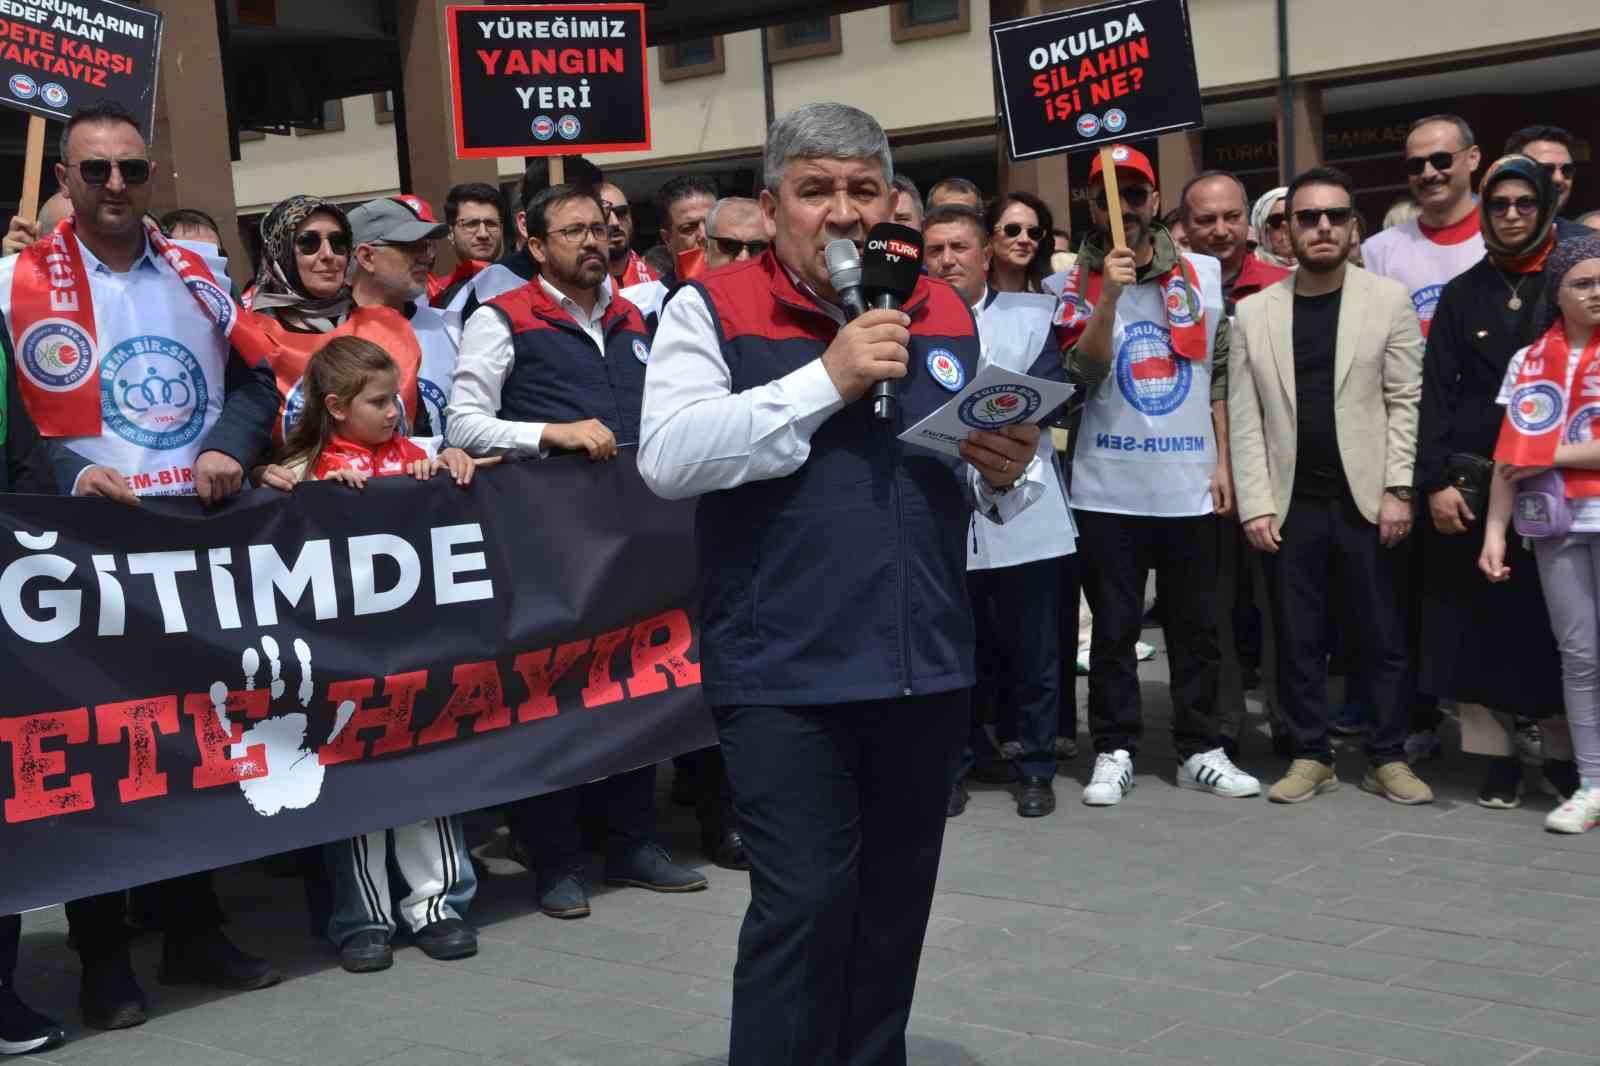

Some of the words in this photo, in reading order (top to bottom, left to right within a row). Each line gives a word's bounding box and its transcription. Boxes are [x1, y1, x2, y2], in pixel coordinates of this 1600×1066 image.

[22, 0, 145, 39] RUMLARINI
[51, 16, 104, 43] ALAN
[478, 17, 626, 39] YÜREĞİMİZ
[61, 37, 133, 75] KARŞI
[1028, 13, 1145, 70] OKULDA
[477, 48, 625, 75] YANGIN
[1033, 37, 1149, 97] SİLAHIN
[516, 78, 592, 109] YERİ
[1045, 89, 1082, 121] İŞİ
[1091, 67, 1144, 105] NE?
[868, 240, 888, 250] ON
[885, 252, 900, 263] TV
[101, 338, 197, 381] BEM-BİR-SEN
[0, 522, 494, 643] ĞİTİMDE
[0, 689, 270, 823] ETE
[319, 609, 701, 765] HAYIR
